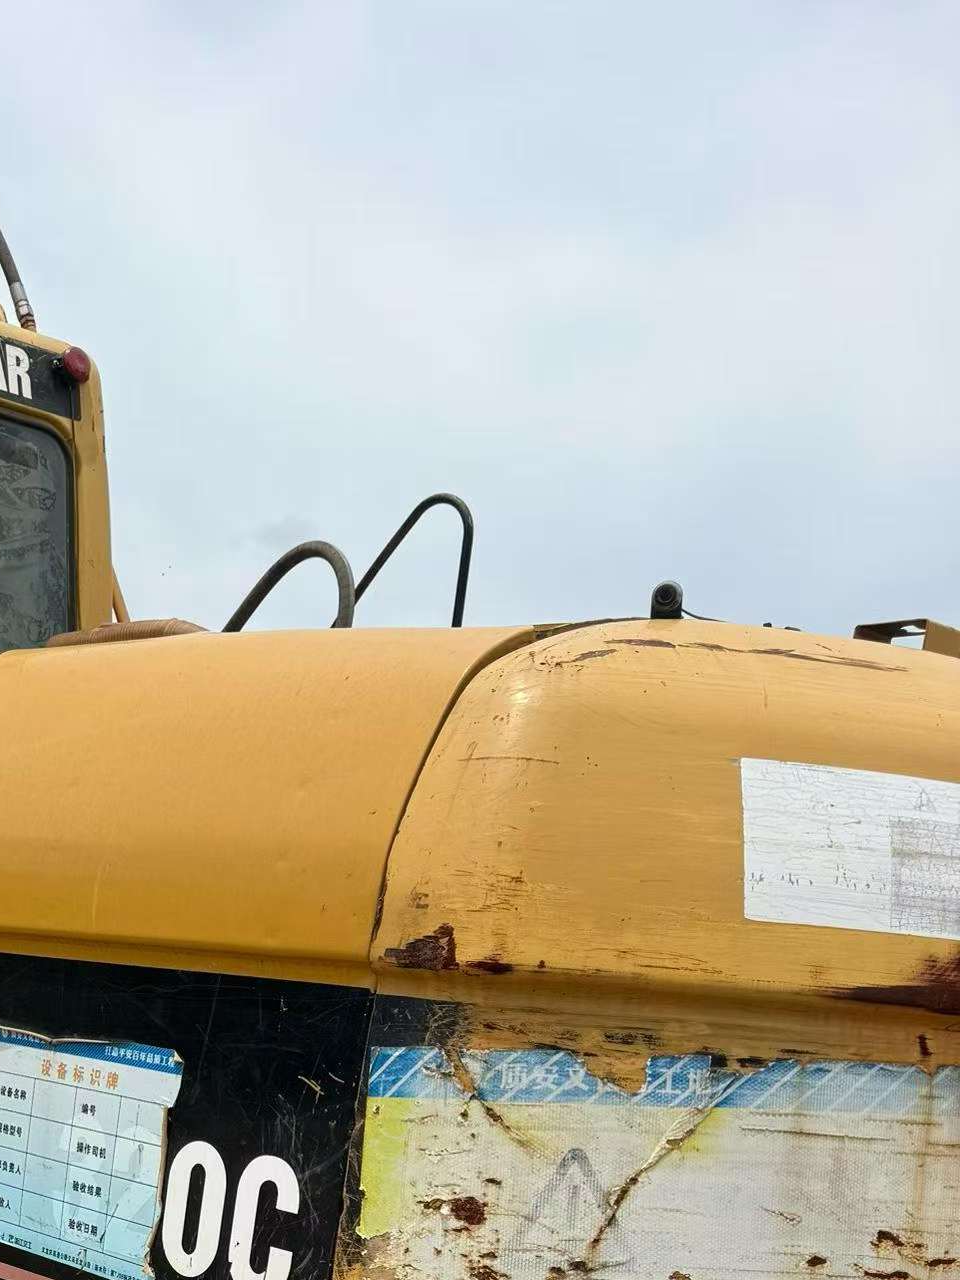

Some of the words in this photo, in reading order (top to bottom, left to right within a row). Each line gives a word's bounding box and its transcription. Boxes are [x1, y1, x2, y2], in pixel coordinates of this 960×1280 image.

[41, 1058, 120, 1090] 设备标识牌
[0, 1085, 27, 1101] 设备名称
[81, 1103, 97, 1118] 编号
[76, 1142, 107, 1160] 操作司机
[72, 1180, 102, 1198] 验收结果
[68, 1218, 99, 1237] 验收日期
